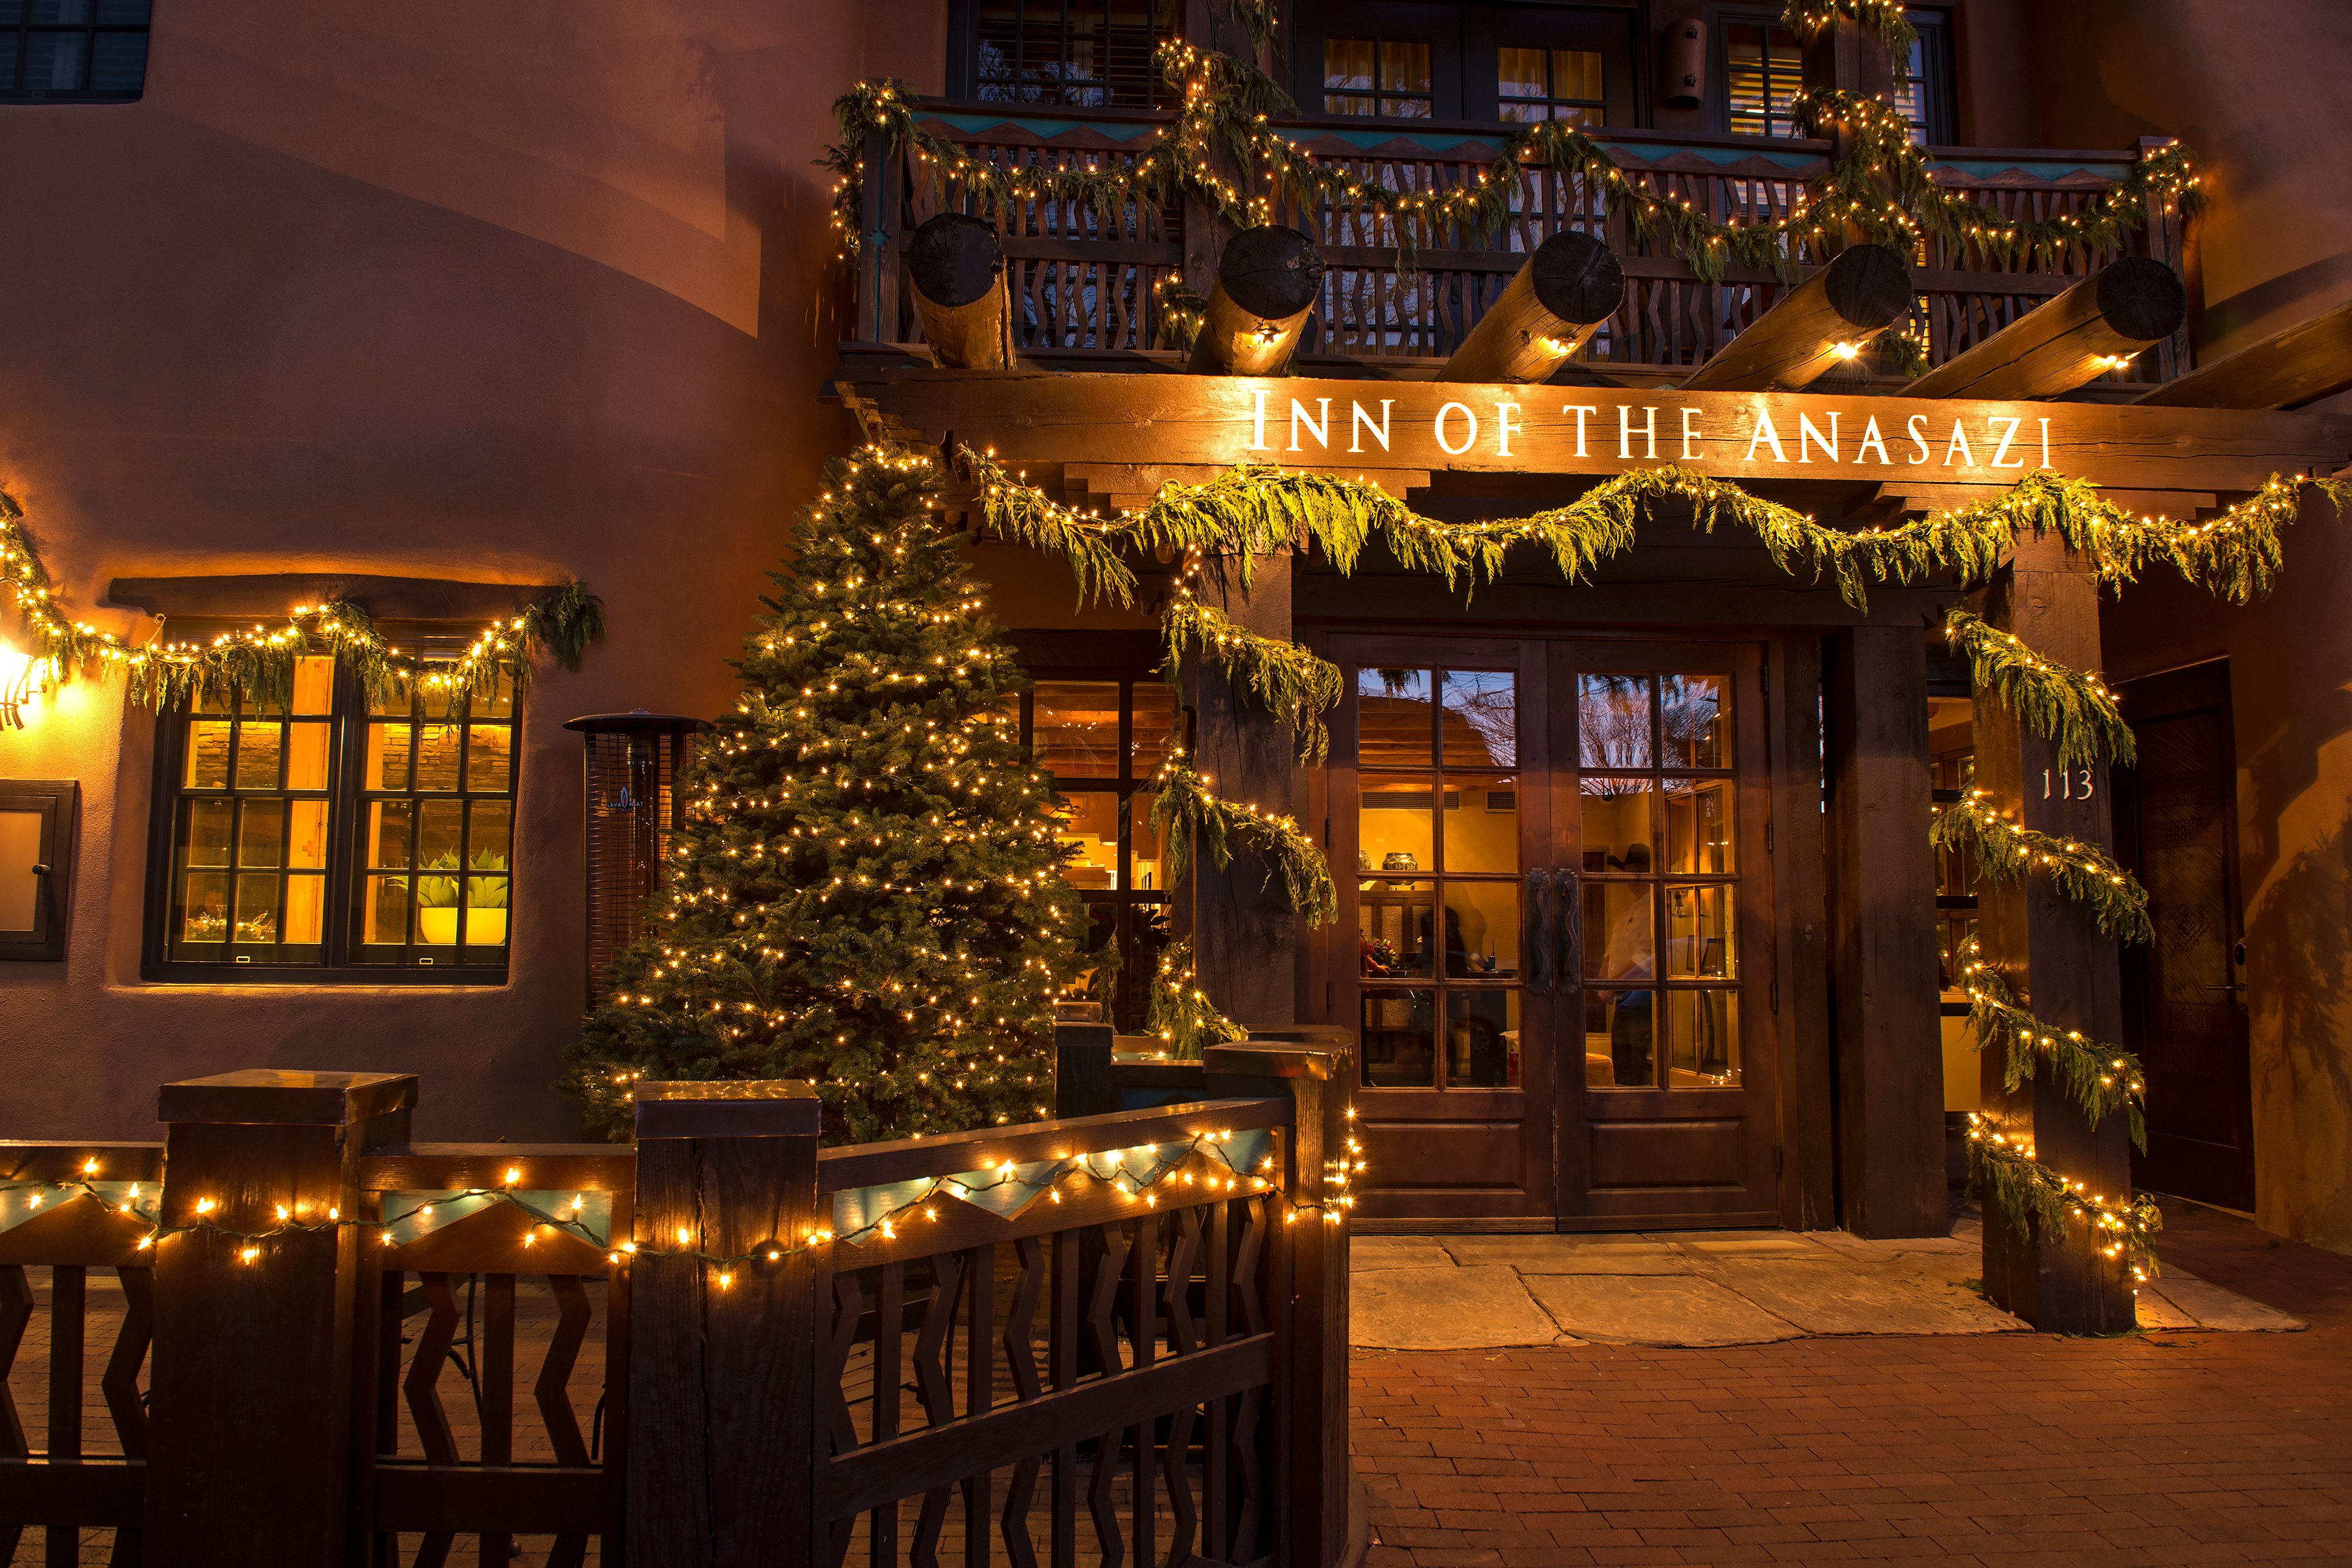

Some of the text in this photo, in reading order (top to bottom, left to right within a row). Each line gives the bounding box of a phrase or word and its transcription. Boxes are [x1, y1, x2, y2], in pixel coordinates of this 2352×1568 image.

[1248, 389, 2055, 469] INN OF THE ANASAZI
[2042, 768, 2094, 800] 113
